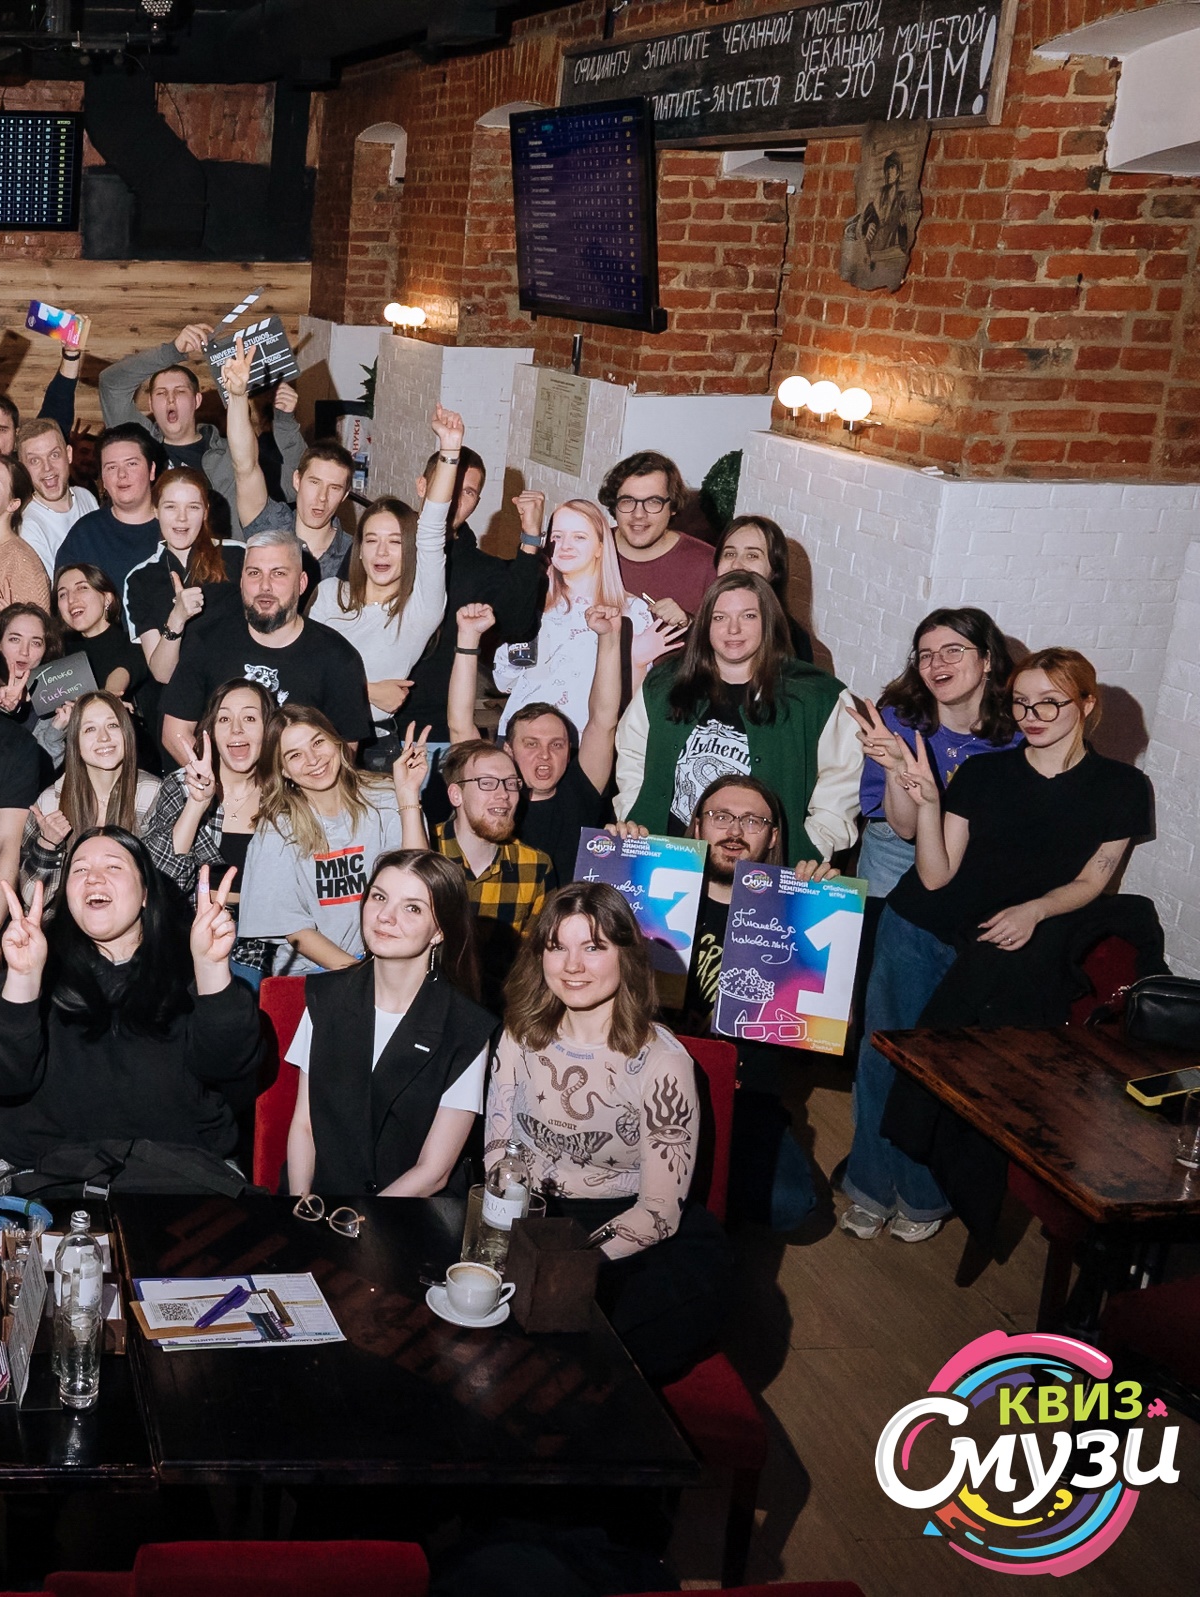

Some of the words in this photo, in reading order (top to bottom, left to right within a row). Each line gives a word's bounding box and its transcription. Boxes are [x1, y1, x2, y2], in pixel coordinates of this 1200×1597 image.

[574, 50, 630, 85] ОФИЦИАНТУ
[642, 31, 711, 70] ЗАПЛАТИТЕ
[722, 11, 794, 55] ЧЕКАННОЙ
[803, 0, 882, 38] МОНЕТОЙ
[801, 26, 885, 72] ЧЕКАННОЙ
[892, 6, 986, 56] МОНЕТОЙ
[836, 60, 875, 99] ЭТО
[887, 15, 997, 120] ВАМ!
[741, 873, 773, 889] Смузи
[778, 884, 821, 896] ЧЕМПИОНАТ
[796, 909, 864, 1022] 1
